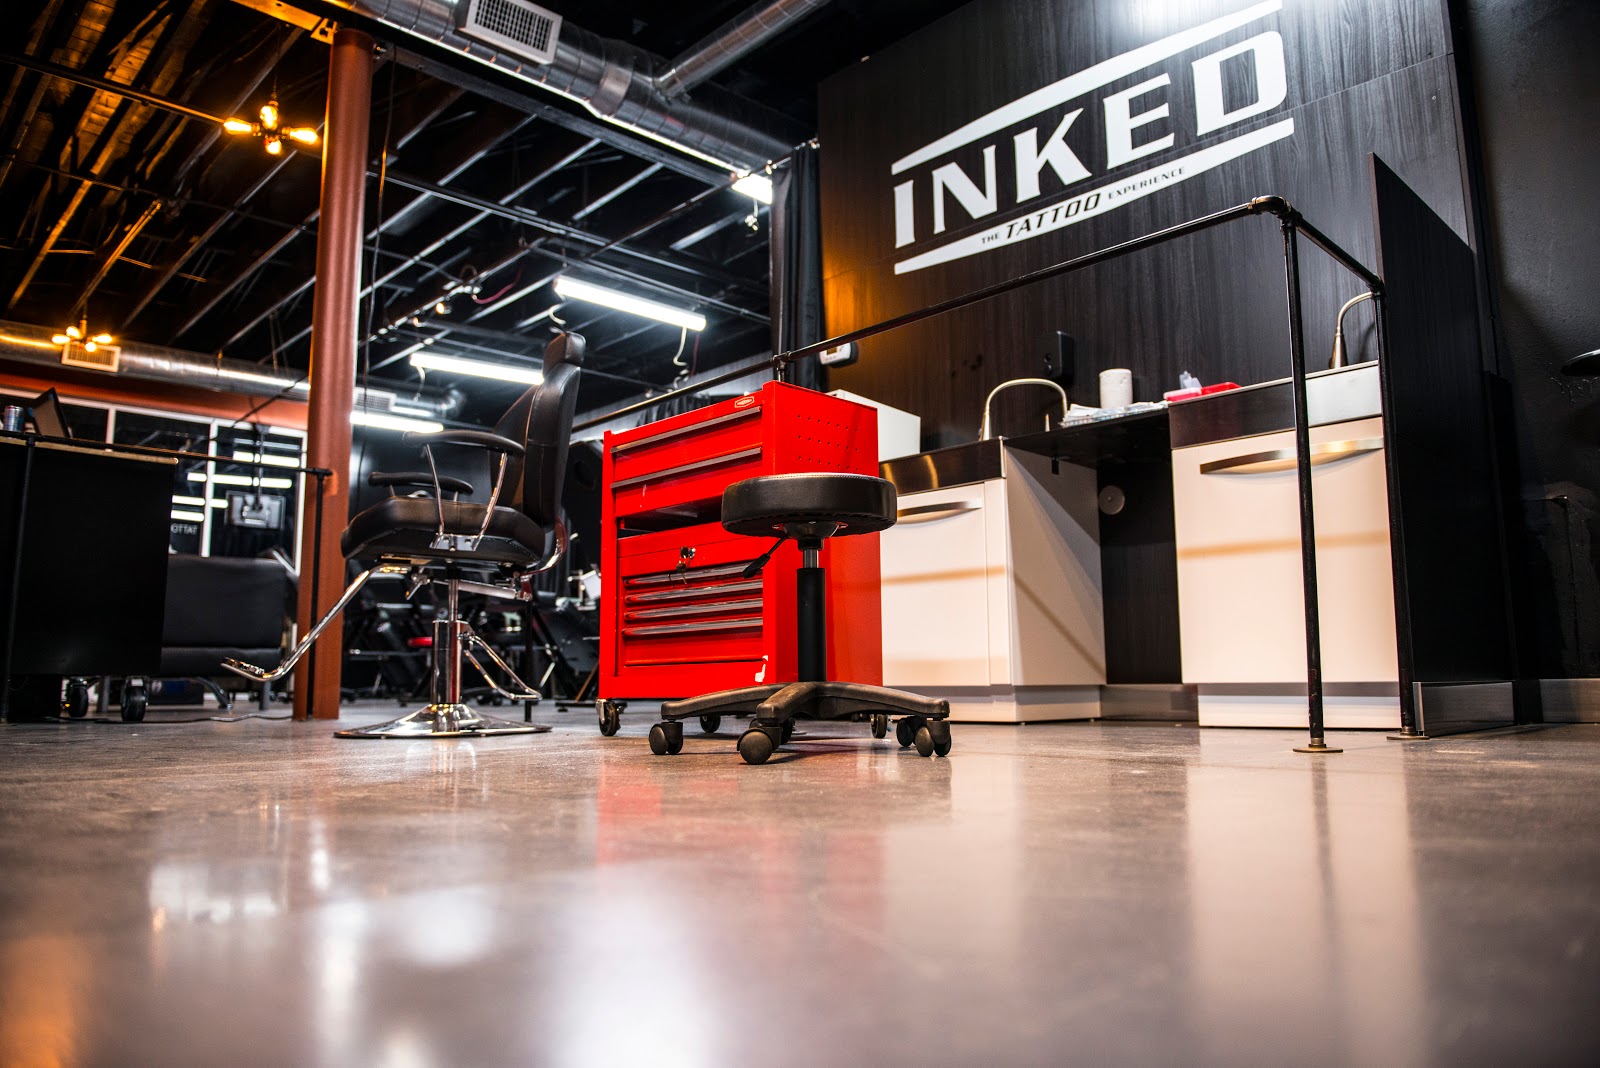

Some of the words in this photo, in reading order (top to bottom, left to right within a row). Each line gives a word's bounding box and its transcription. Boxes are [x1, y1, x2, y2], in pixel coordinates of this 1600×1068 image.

[893, 30, 1288, 249] INKED
[981, 232, 1000, 245] THE
[1006, 193, 1101, 240] TATTOO
[1108, 166, 1186, 199] EXPERIENCE
